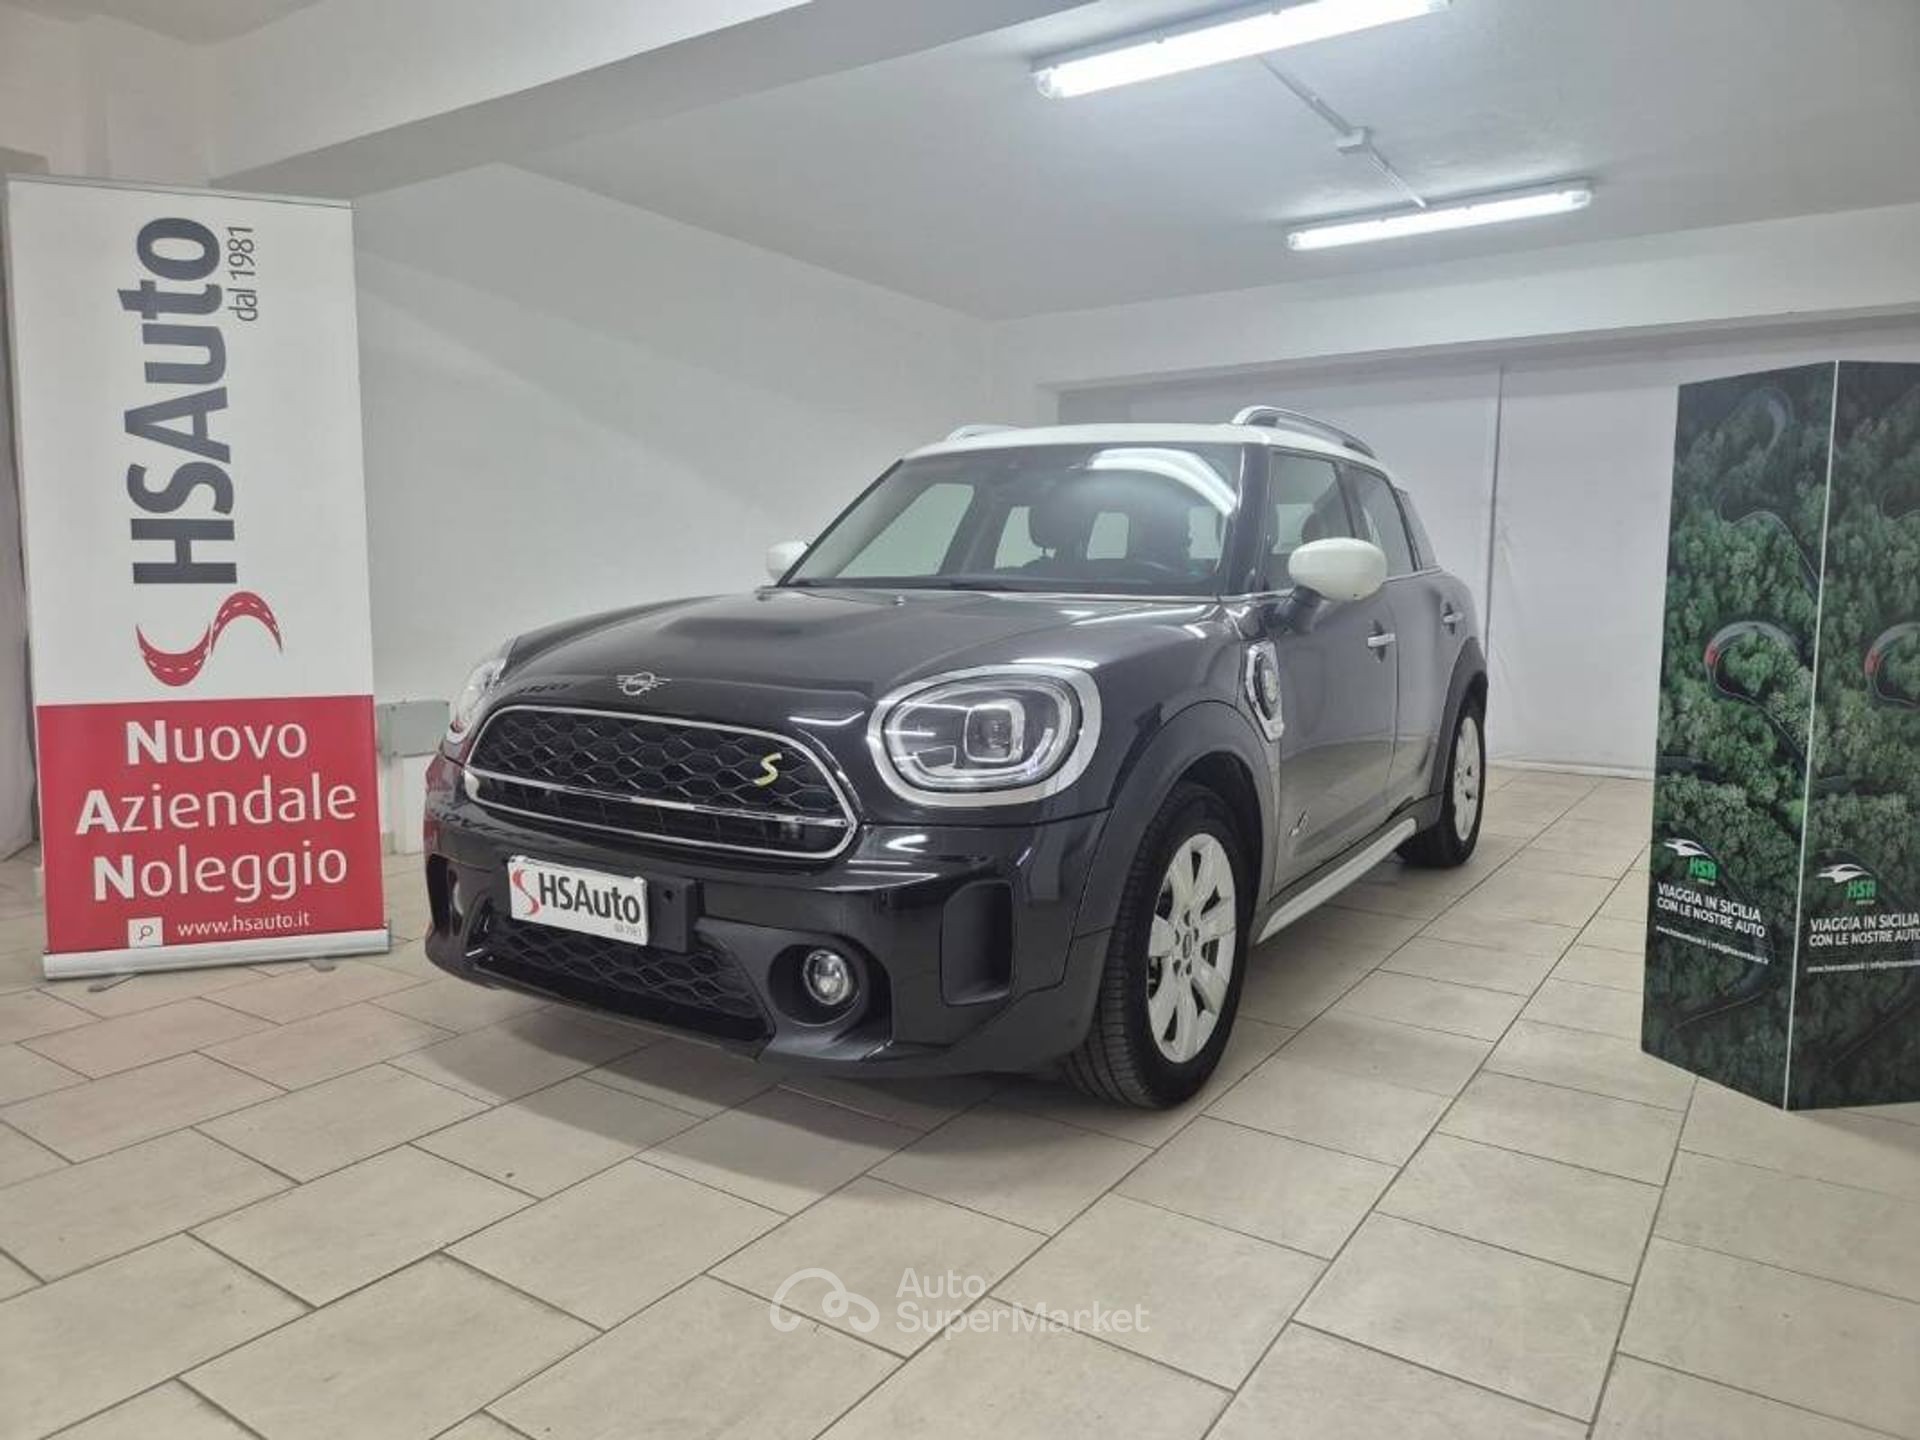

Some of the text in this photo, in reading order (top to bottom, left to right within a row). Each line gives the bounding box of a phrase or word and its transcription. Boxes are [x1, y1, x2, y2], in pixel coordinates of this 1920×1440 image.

[227, 226, 257, 322] dal 1981
[118, 217, 237, 584] HSAuto
[126, 720, 308, 765] Nuovo
[753, 752, 783, 787] S
[75, 772, 357, 835] Aziendale
[93, 840, 347, 903] Noleggio
[538, 872, 641, 924] HSAuto
[1657, 897, 1765, 938] CON LE NOSTRE AUTO
[1658, 882, 1761, 922] VIAGGIA IN SICILIA
[177, 911, 310, 936] www.hsauto.it
[1809, 934, 1833, 947] CON
[1835, 933, 1849, 946] LE
[1851, 930, 1894, 944] NOSTRE
[1810, 912, 1919, 932] VIAGGIA IN SICILIA
